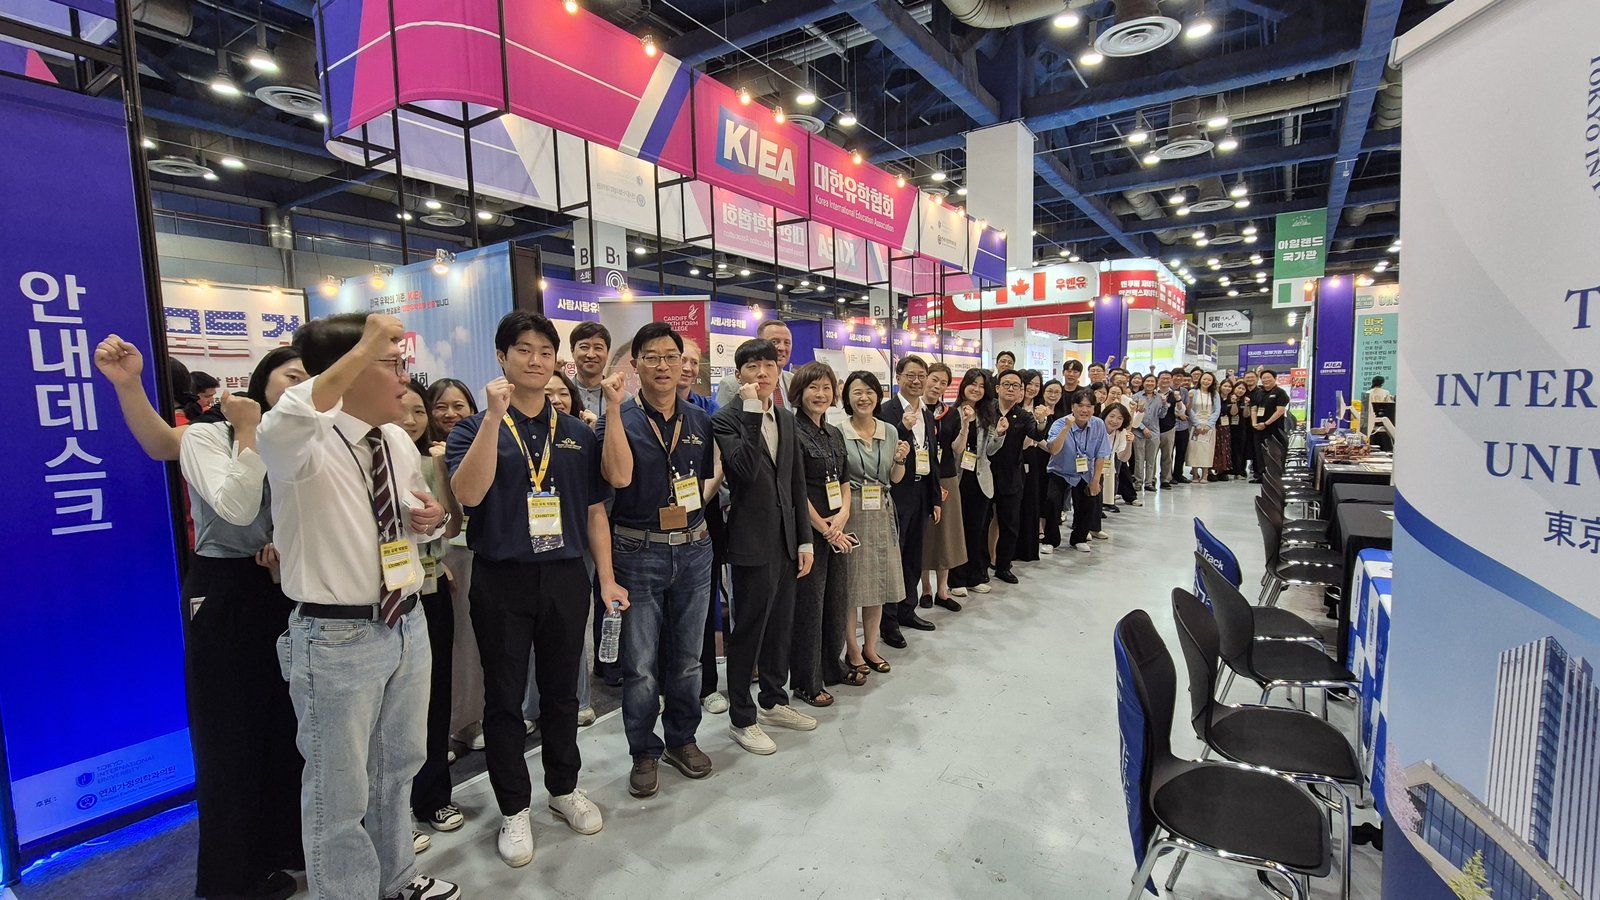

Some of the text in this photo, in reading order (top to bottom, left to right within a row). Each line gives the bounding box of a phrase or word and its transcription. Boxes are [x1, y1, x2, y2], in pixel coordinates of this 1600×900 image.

[723, 118, 796, 186] KIEA
[814, 161, 894, 220] 대한유학협회
[814, 193, 895, 233] Korea International Education Association
[1278, 236, 1323, 250] 아일랜드
[606, 246, 621, 266] B1
[1282, 250, 1318, 262] 국가관
[557, 298, 600, 314] 사람사랑유
[19, 271, 113, 536] 안내데스크
[1202, 547, 1225, 571] Track
[97, 759, 123, 772] TOKYO
[97, 755, 155, 777] INTERNATIONAL
[99, 765, 176, 798] 연세가정의학과의원
